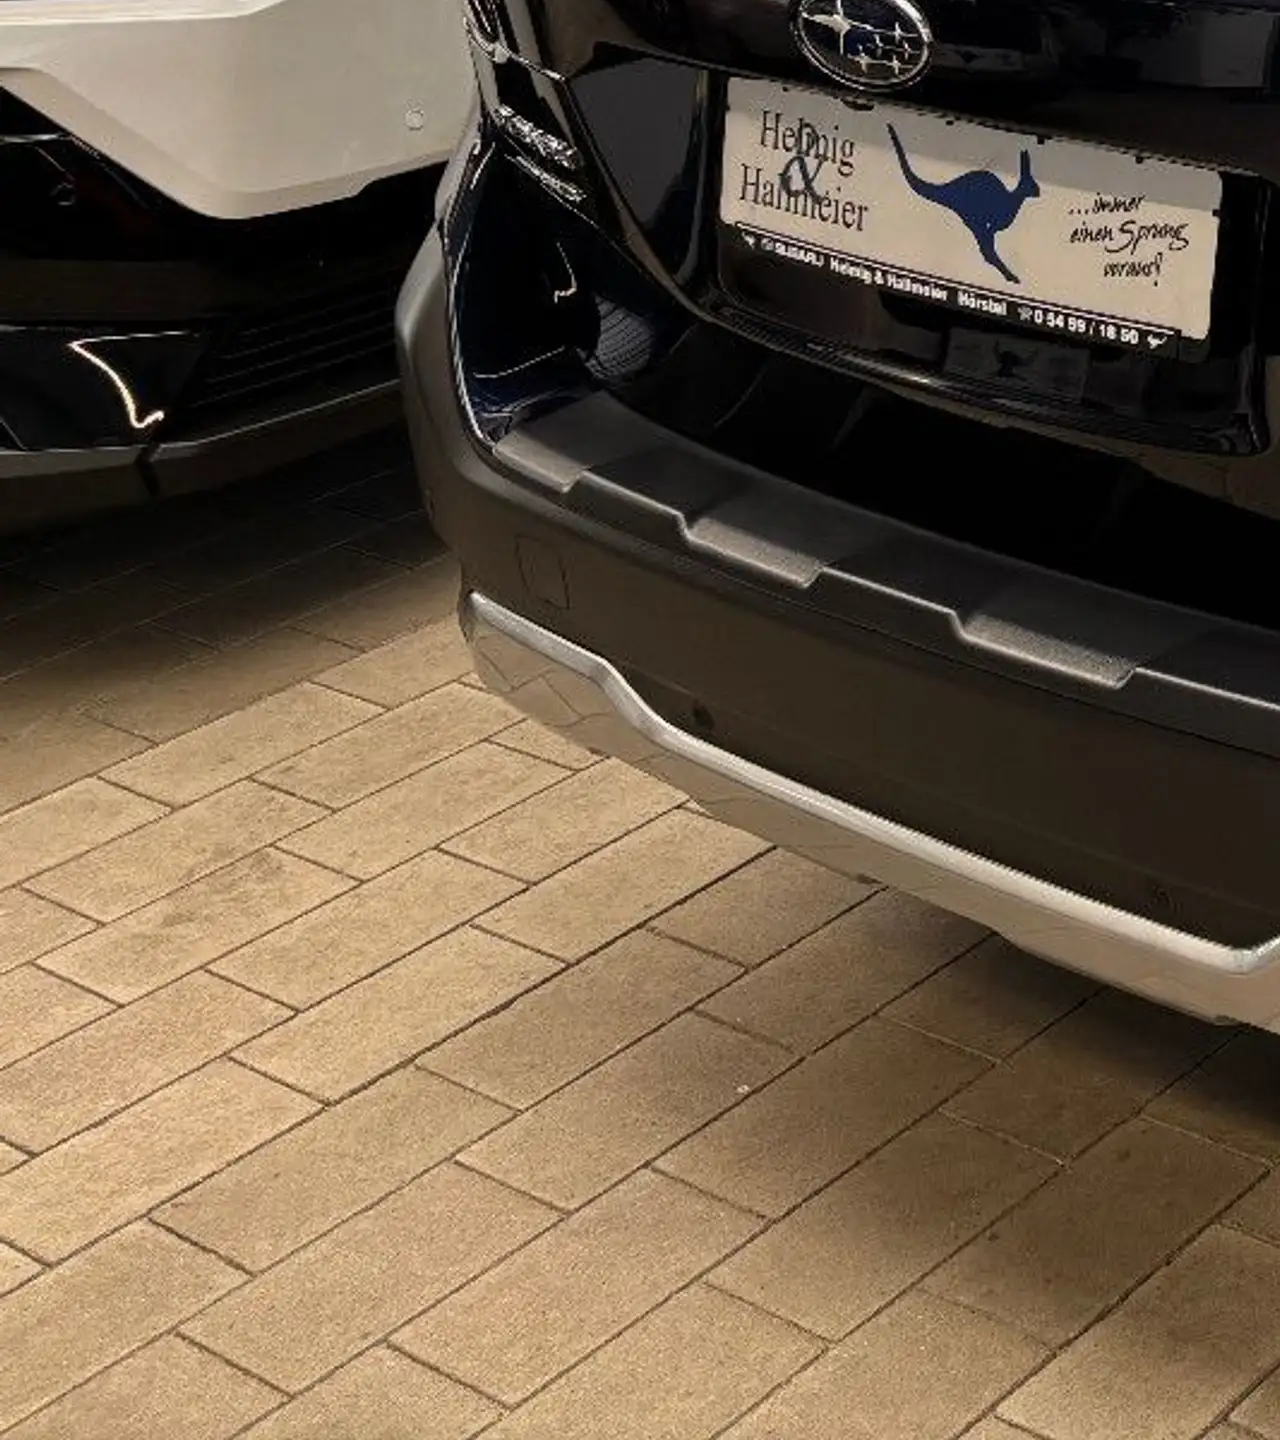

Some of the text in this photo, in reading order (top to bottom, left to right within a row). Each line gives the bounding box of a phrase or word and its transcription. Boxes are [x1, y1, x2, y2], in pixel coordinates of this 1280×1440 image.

[1069, 219, 1190, 256] einen Sprung
[873, 269, 885, 286] &
[1033, 308, 1044, 324] 0
[1045, 312, 1065, 329] 54
[1099, 323, 1118, 341] 18
[1119, 327, 1140, 346] 50
